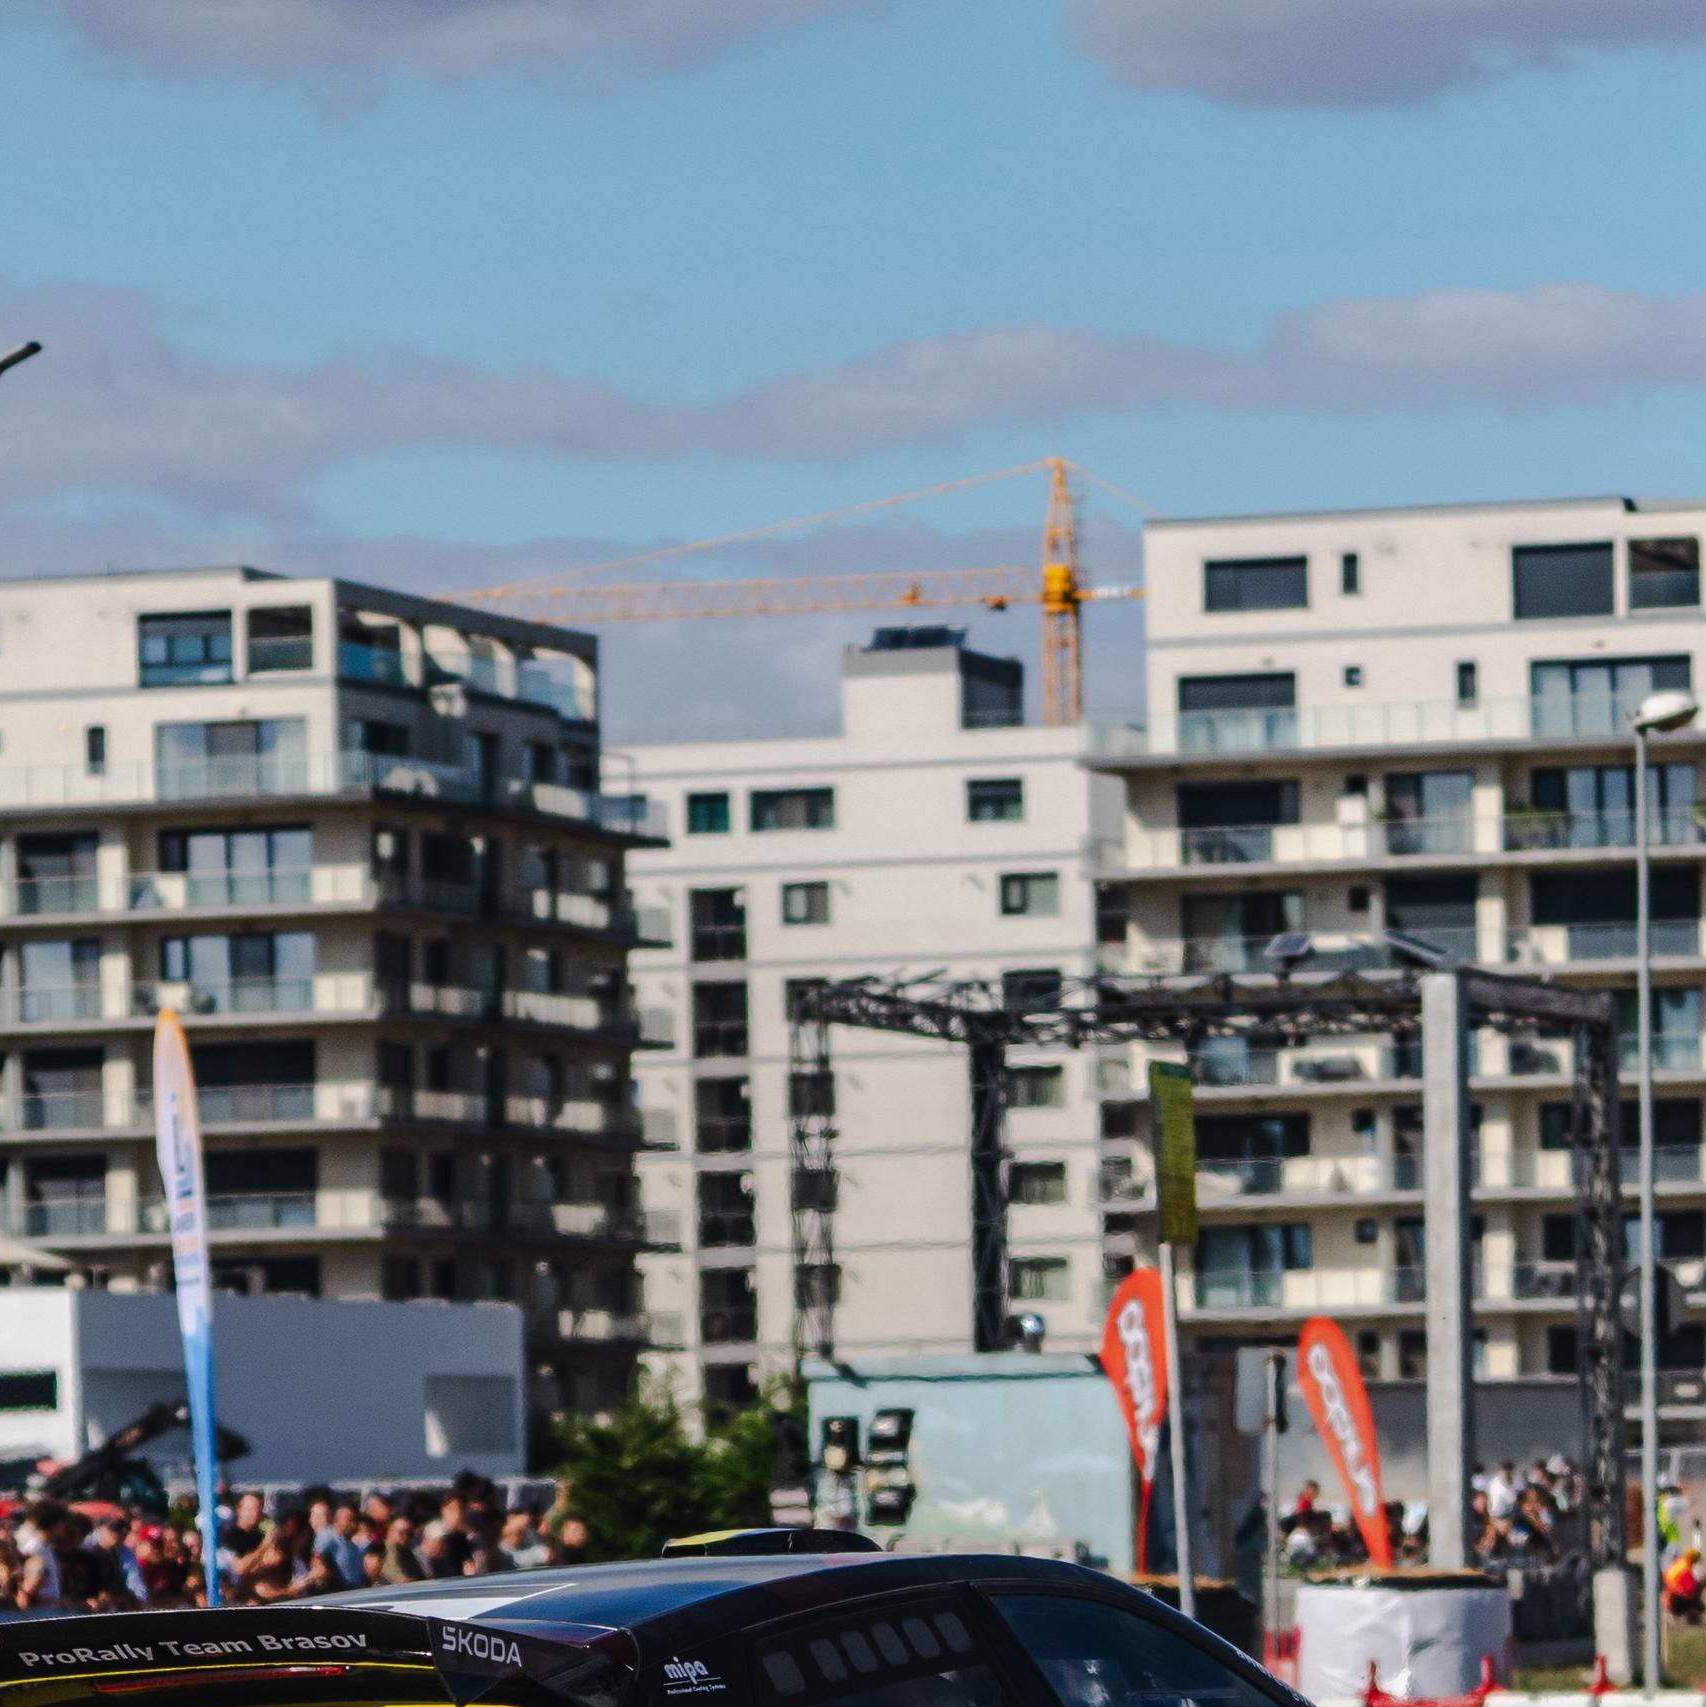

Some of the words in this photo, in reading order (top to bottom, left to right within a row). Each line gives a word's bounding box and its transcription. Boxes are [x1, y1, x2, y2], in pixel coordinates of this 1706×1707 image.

[18, 1643, 155, 1668] ProRally
[158, 1638, 253, 1657] Team
[257, 1633, 367, 1651] Brasov
[663, 1656, 709, 1685] mipa
